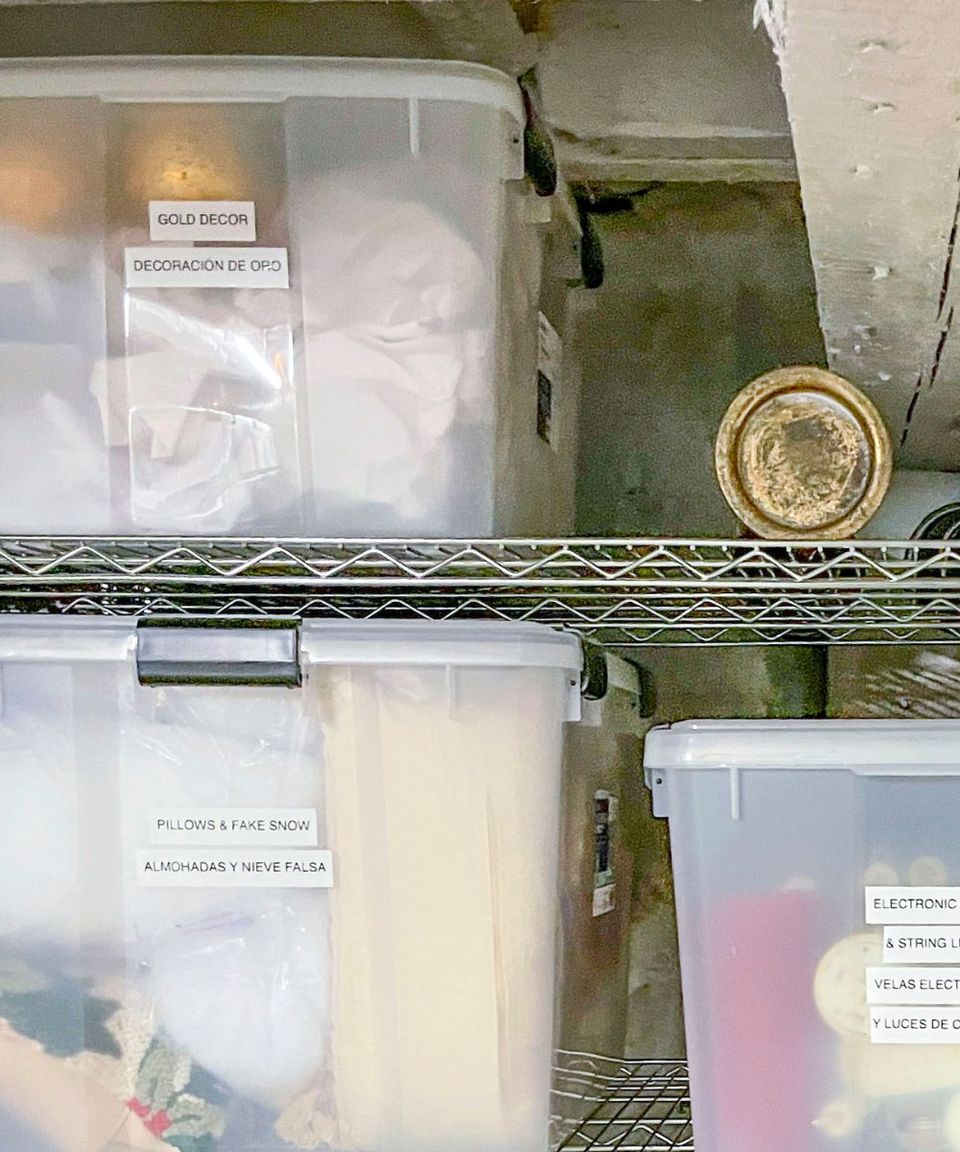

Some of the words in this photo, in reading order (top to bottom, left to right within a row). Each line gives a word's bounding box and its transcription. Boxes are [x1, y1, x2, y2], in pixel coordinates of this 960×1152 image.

[158, 214, 195, 226] GOLD
[200, 214, 248, 226] DECOR
[228, 260, 246, 271] DE
[158, 819, 215, 831] PILLOWS
[220, 820, 227, 830] &
[232, 819, 265, 831] FAKE
[269, 820, 310, 831] SNOW
[144, 861, 226, 872] ALMOHADAS
[230, 862, 238, 872] Y
[242, 862, 281, 872] NIEVE
[286, 862, 326, 872] FALSA
[874, 899, 956, 909] ELECTRONIC
[887, 938, 894, 948] &
[898, 938, 946, 948] STRING
[875, 979, 915, 990] VELAS
[873, 1018, 880, 1029] Y
[885, 1018, 927, 1029] LUCES
[932, 1019, 948, 1029] DE
